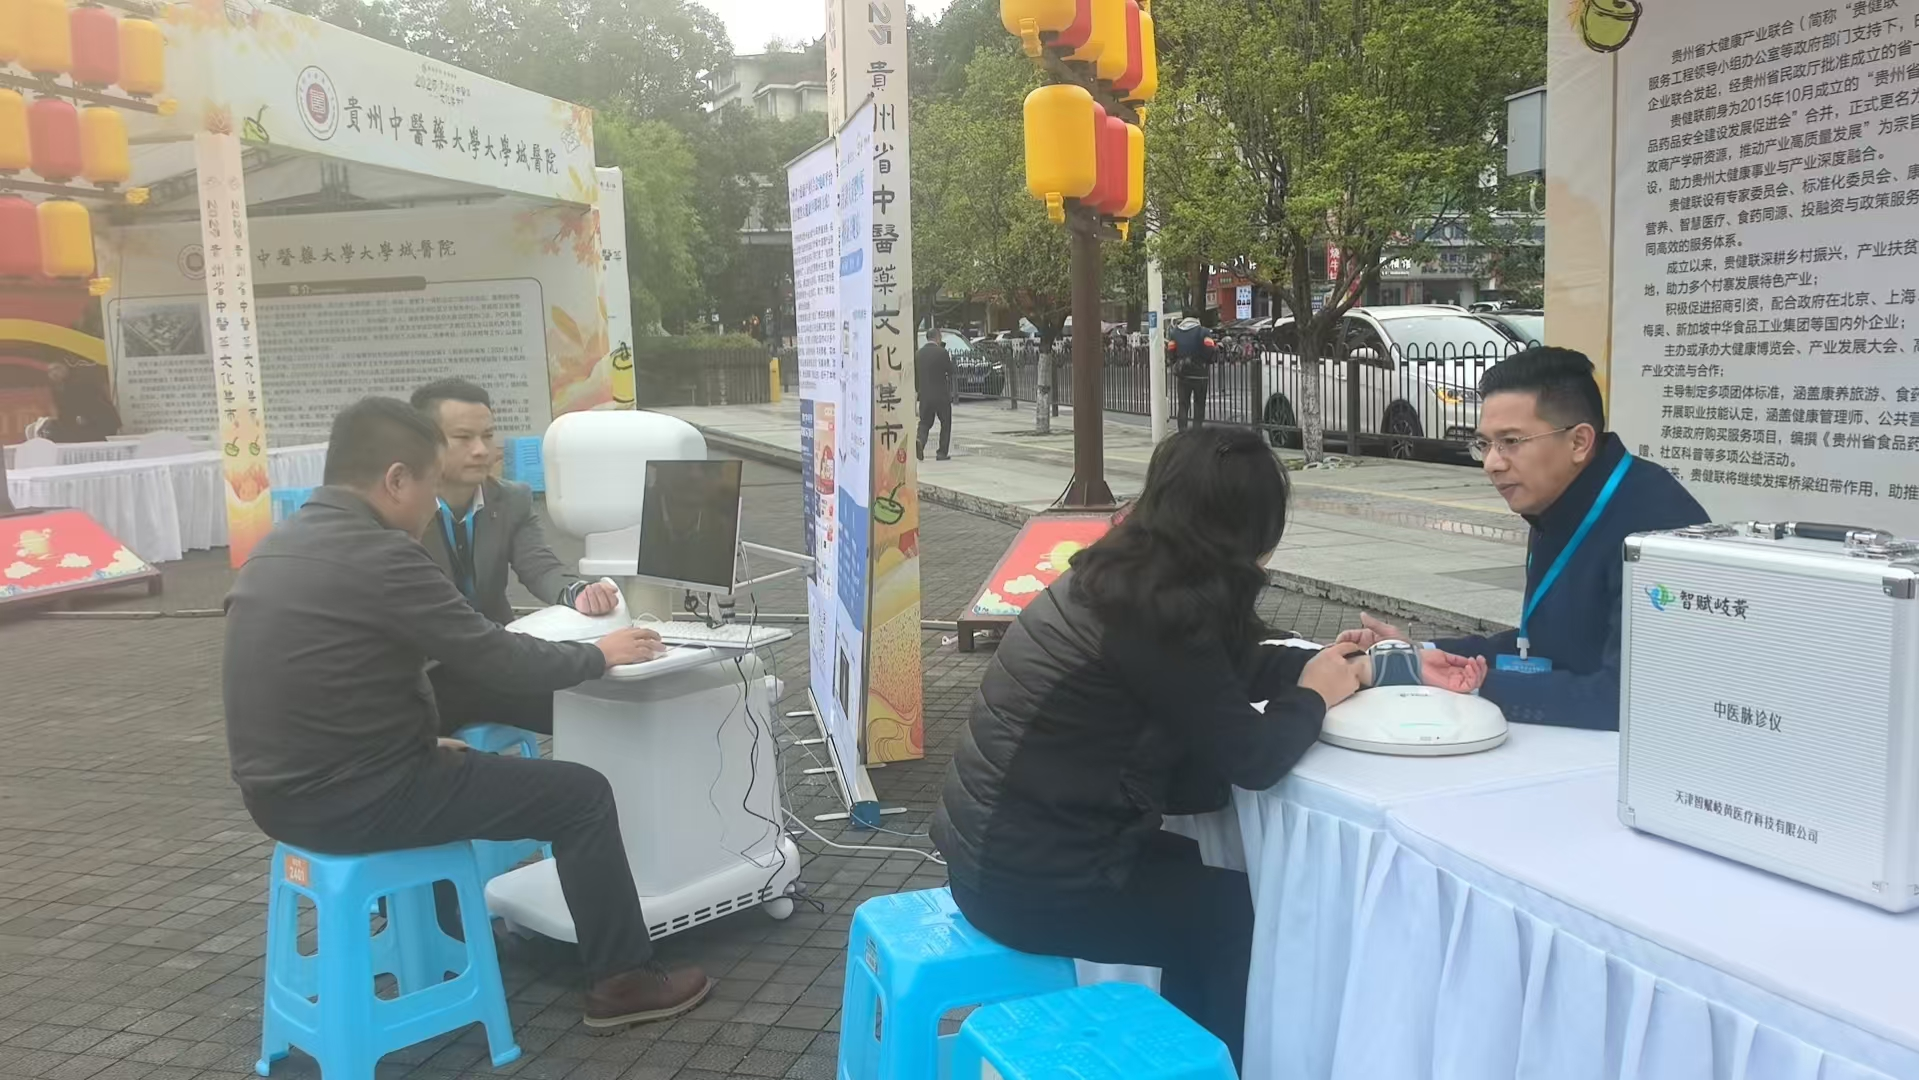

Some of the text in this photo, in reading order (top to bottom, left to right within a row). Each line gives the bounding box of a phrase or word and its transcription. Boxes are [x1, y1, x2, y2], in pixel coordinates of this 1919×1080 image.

[1665, 288, 1919, 317] 积极促进招商引资，配合政府在北京、上海
[1641, 363, 1725, 378] 产业交流与合作；
[1664, 465, 1919, 501] 来，贵健联将继续发挥桥梁纽带作用，助推
[1713, 701, 1782, 732] 中医脉诊仪
